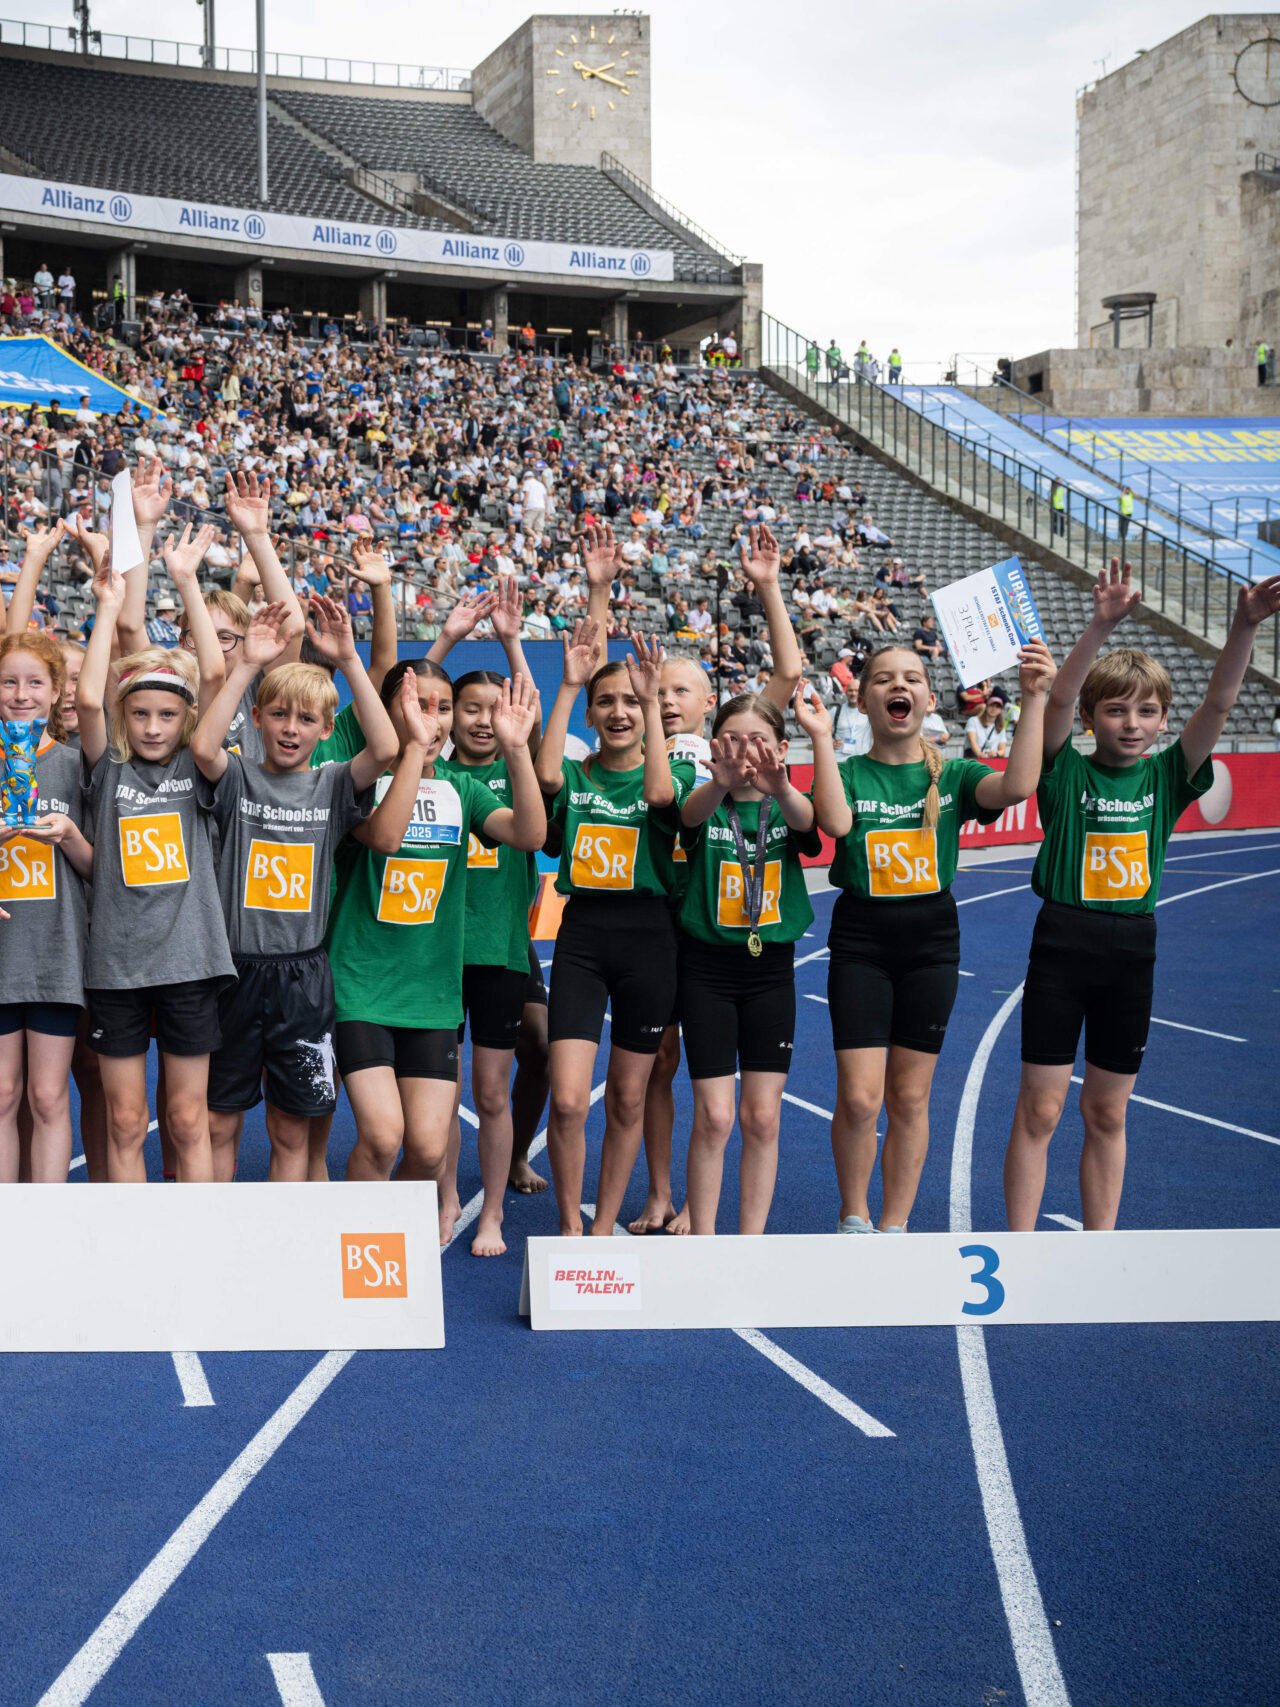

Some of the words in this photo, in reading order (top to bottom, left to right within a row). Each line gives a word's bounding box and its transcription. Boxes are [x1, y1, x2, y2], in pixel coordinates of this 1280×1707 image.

[41, 187, 105, 215] Allianz
[178, 207, 239, 233] Allianz
[312, 225, 372, 248] Allianz
[442, 239, 500, 261] Allianz
[570, 250, 626, 271] Allianz
[251, 279, 261, 293] G
[116, 784, 138, 801] TAF
[171, 777, 193, 792] Cup
[262, 807, 313, 822] Schools
[411, 799, 437, 822] 16
[854, 800, 878, 814] TAF
[937, 793, 952, 809] up
[125, 828, 182, 872] BSR
[577, 835, 627, 879] BSR
[873, 842, 932, 884] BSR
[253, 853, 306, 899] BSR
[1090, 845, 1145, 889] BSR
[388, 870, 436, 913] BSR
[726, 875, 775, 915] BR
[346, 1244, 403, 1287] BSR
[554, 1269, 616, 1281] BERLIN
[575, 1283, 636, 1295] TALENT
[958, 1244, 1005, 1316] 3
